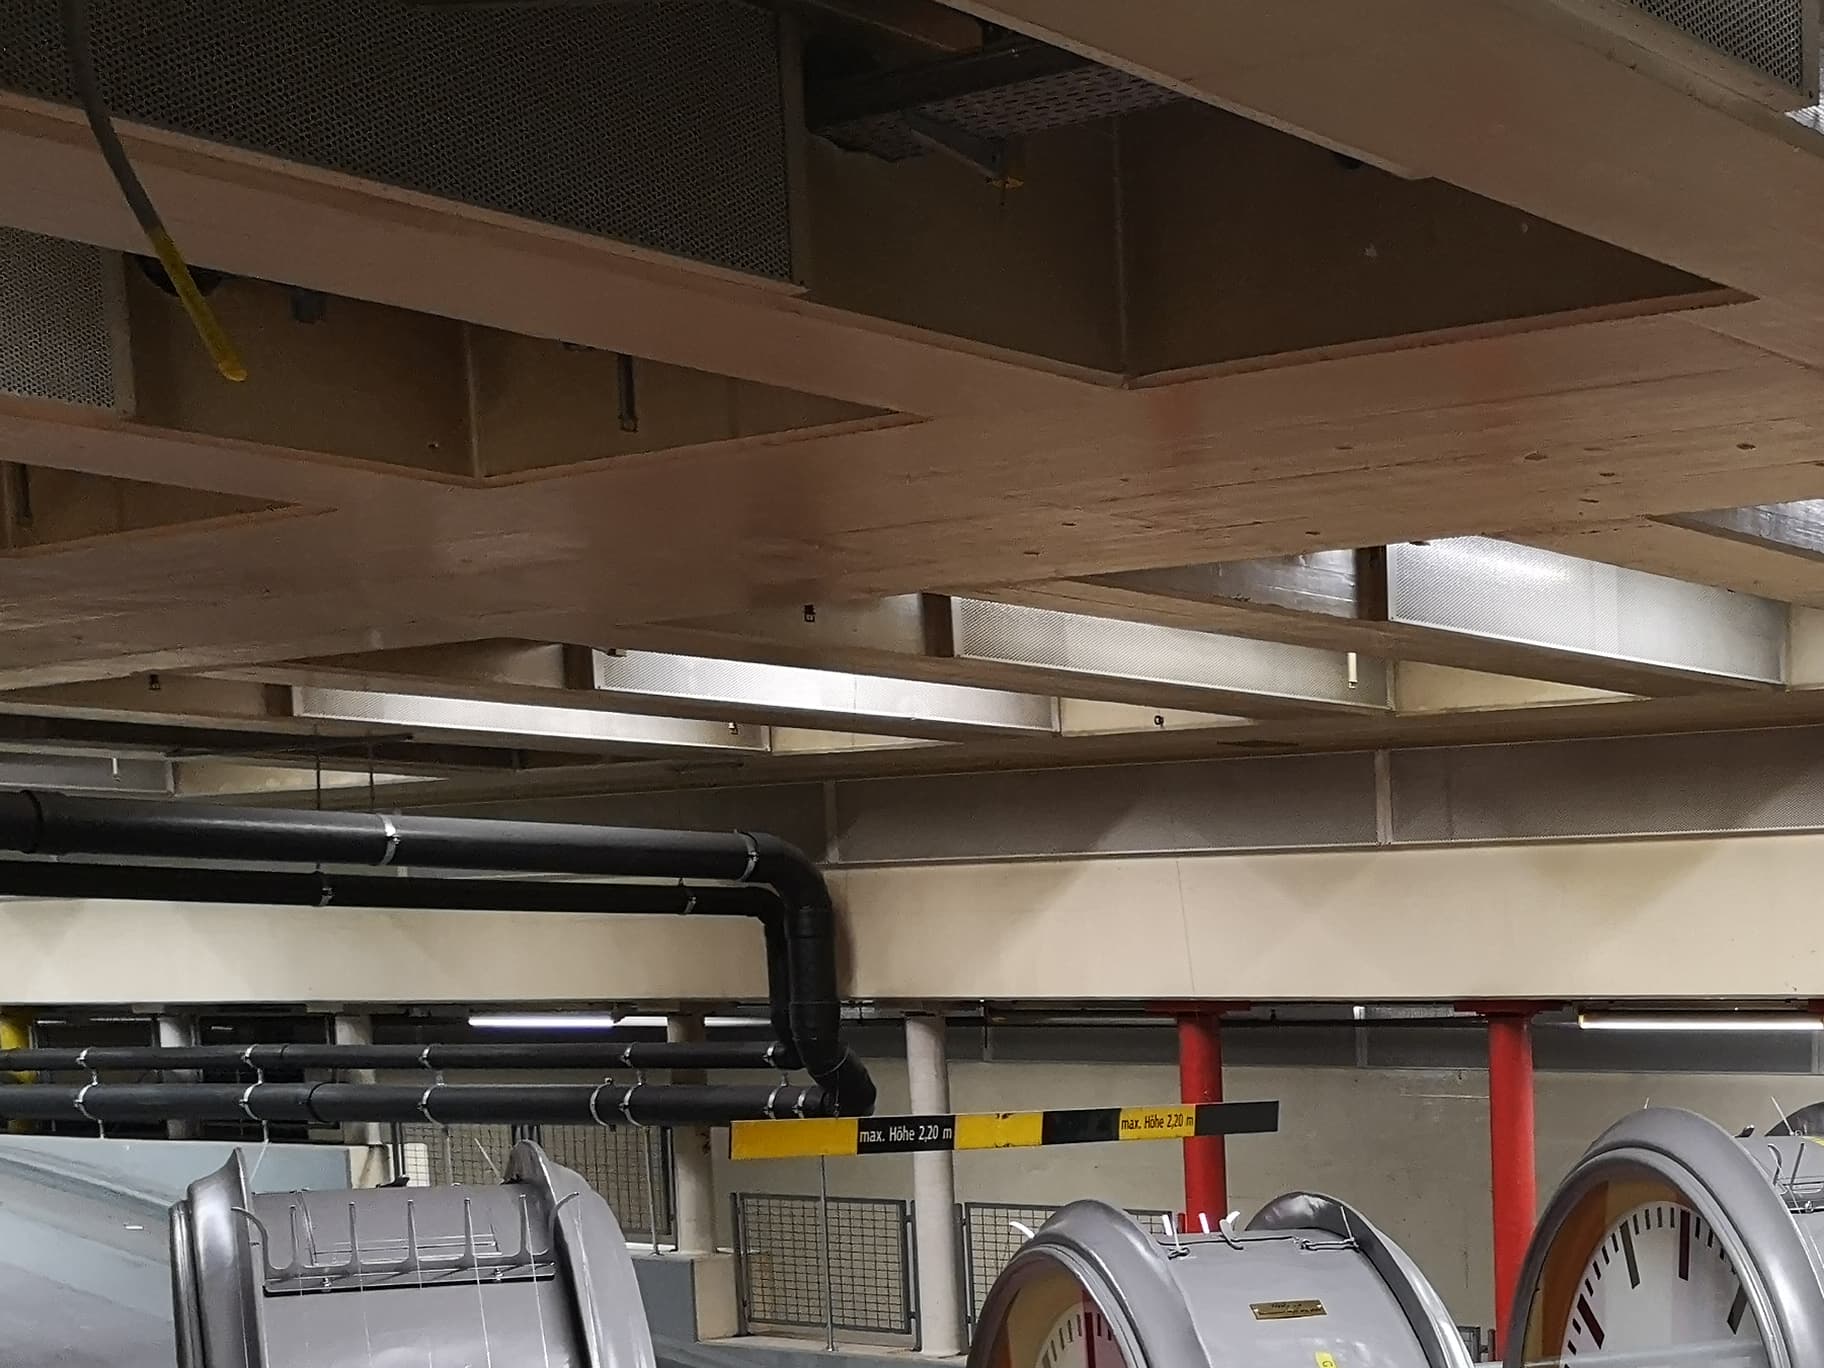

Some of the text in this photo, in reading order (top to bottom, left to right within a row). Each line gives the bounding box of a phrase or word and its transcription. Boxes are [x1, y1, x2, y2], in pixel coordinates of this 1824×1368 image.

[1121, 1113, 1194, 1130] max. Höhe 2,20 m
[860, 1125, 953, 1143] max. Höhe 2,20 m
